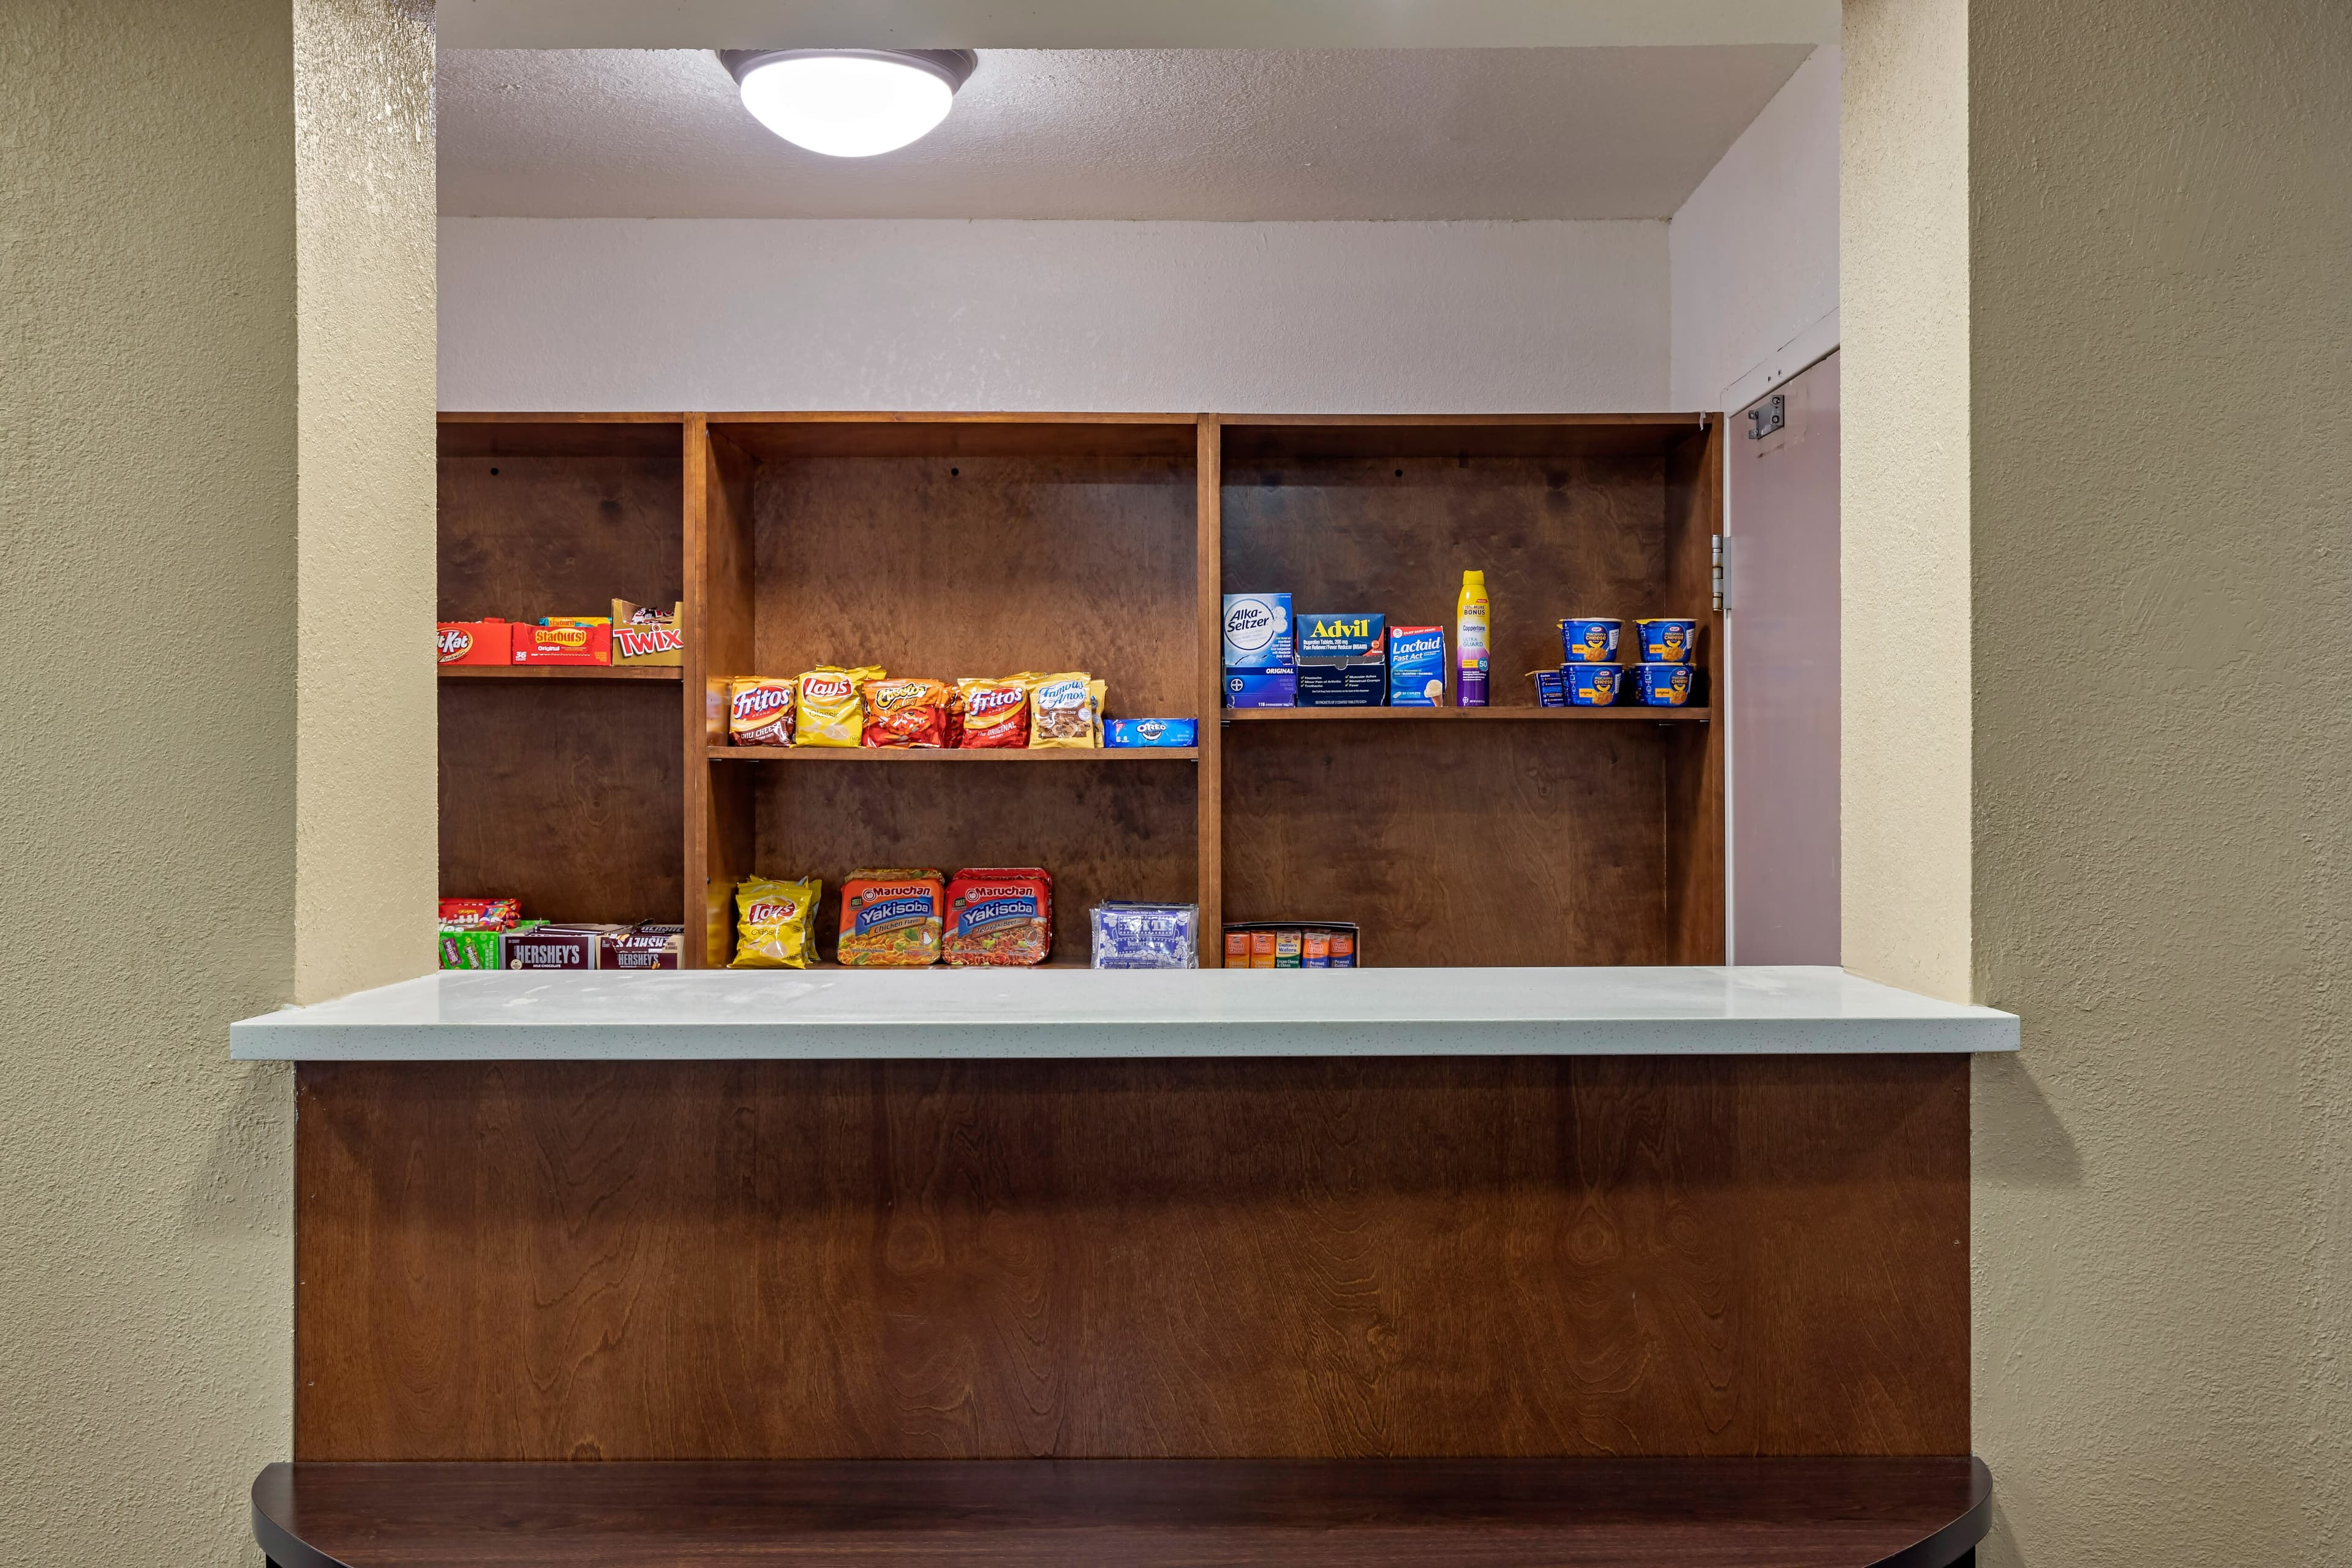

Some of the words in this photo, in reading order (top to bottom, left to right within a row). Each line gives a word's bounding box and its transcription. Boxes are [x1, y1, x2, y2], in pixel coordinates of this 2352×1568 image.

[1229, 609, 1262, 622] Alka-
[1227, 617, 1269, 632] Seltzer
[1310, 619, 1368, 638] Advil
[537, 631, 585, 642] Starburst
[613, 625, 684, 656] Twix
[1393, 636, 1441, 654] Lactaid
[876, 683, 927, 708] Cheeto
[1038, 680, 1084, 703] Famous
[734, 688, 790, 720] Fritos
[968, 688, 1023, 716] Fritos
[1048, 692, 1084, 709] Amos
[809, 709, 842, 718] Classic
[755, 721, 781, 737] CHEES
[987, 721, 1017, 736] ORIGINAL
[1136, 723, 1166, 733] OREO
[873, 886, 931, 896] Maruchan
[976, 886, 1033, 896] Maruchan
[862, 902, 929, 924] Yakisoba
[965, 902, 1033, 924] Yakisoba
[874, 921, 903, 933] Chicken
[976, 923, 1003, 933] Teriyaki
[516, 945, 579, 964] HERSHEY'S
[619, 954, 658, 966] HERSHEY'S
